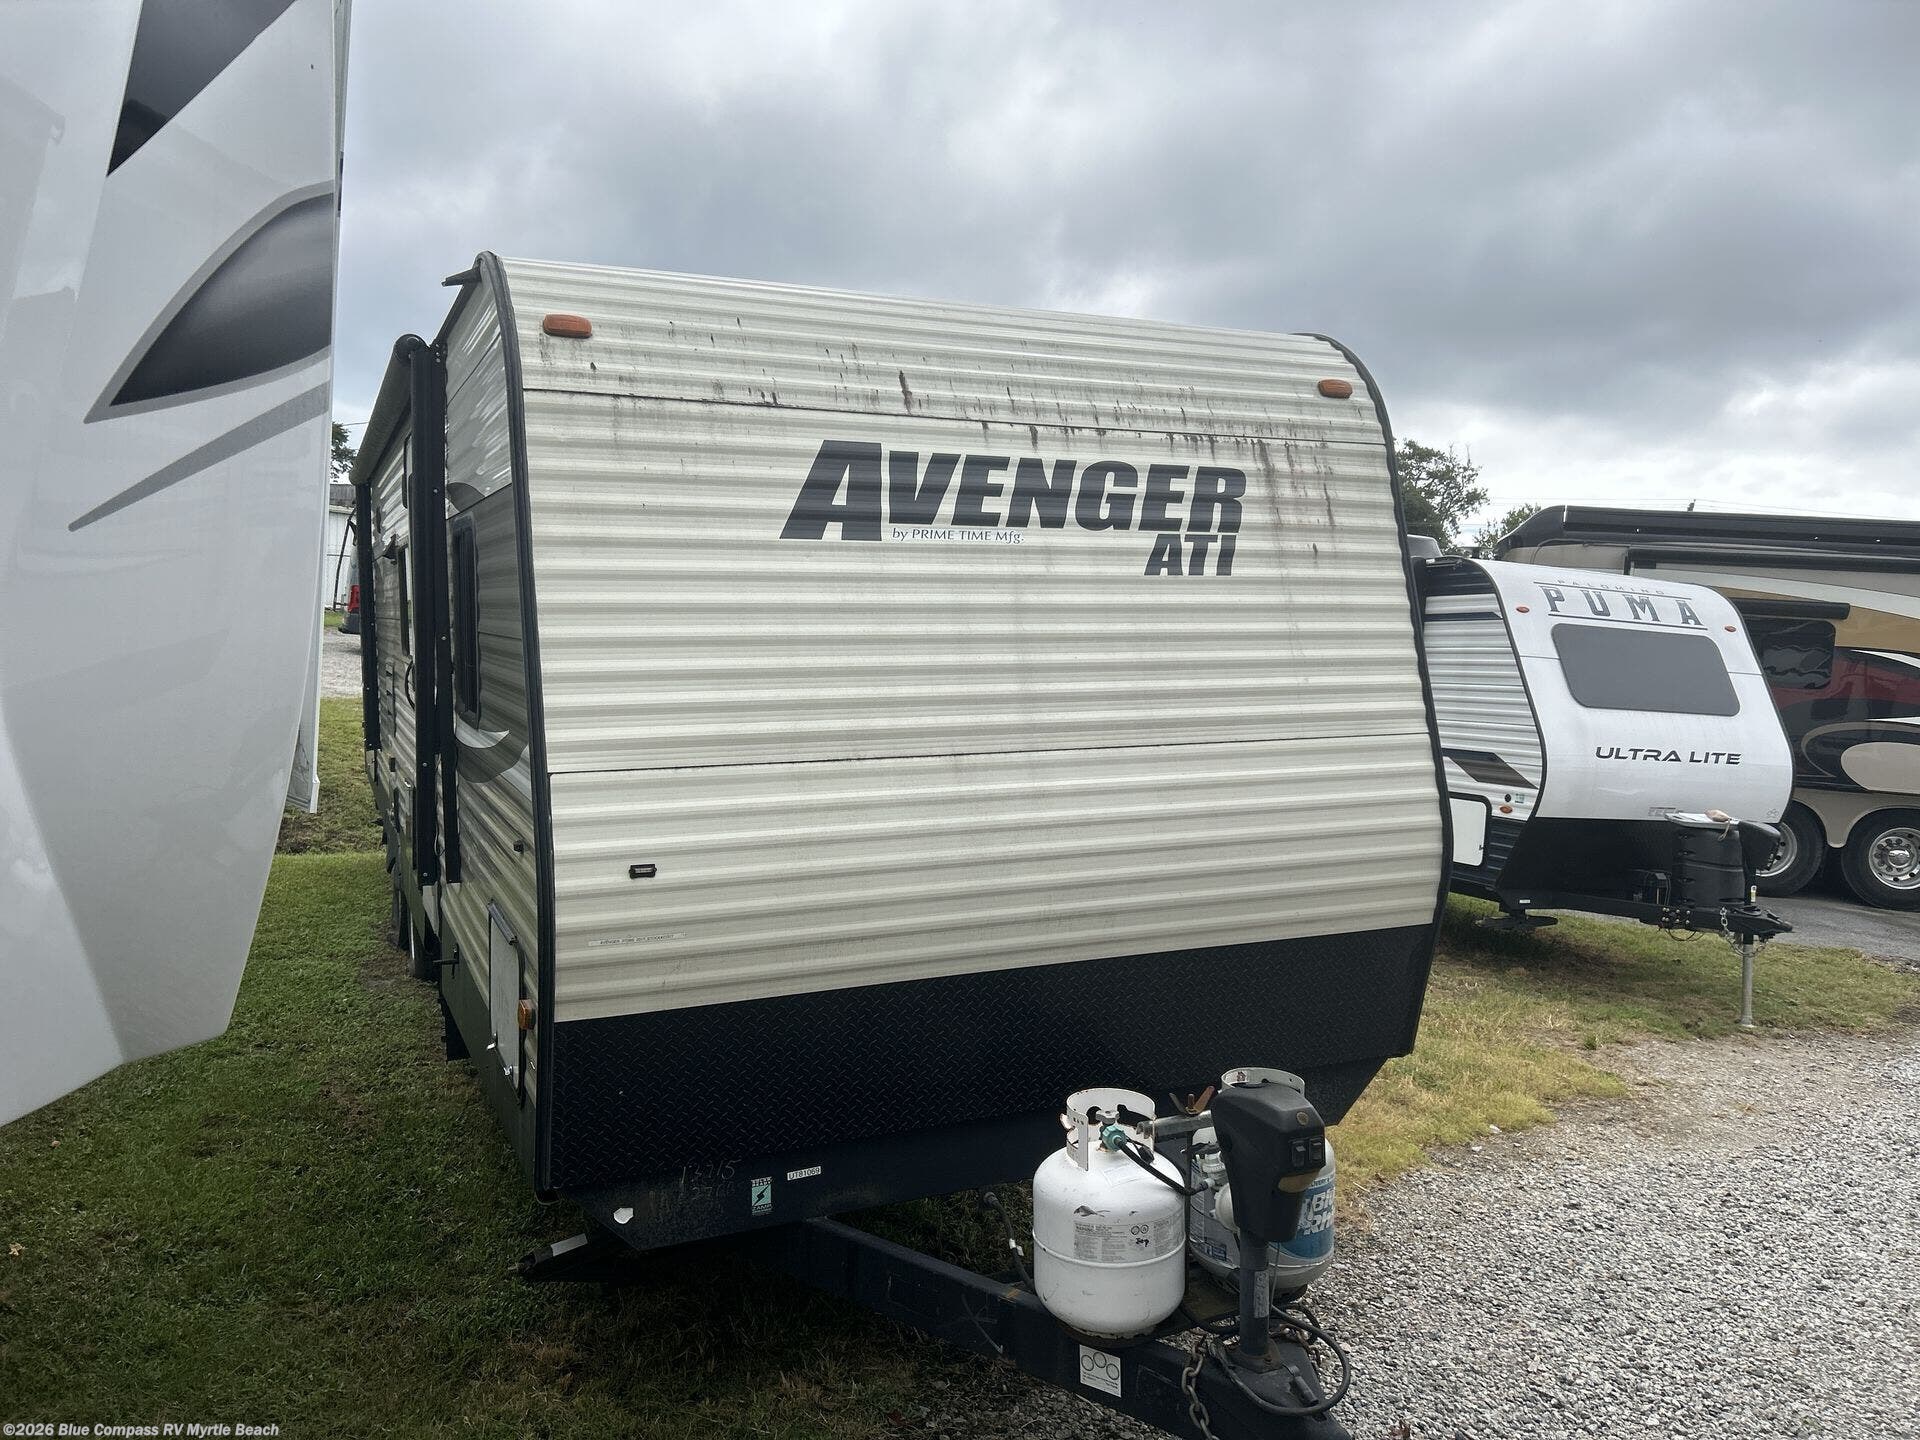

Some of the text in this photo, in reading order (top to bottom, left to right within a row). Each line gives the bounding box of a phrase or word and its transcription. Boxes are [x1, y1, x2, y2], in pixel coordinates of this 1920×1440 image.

[779, 439, 1247, 542] AVENGER
[892, 528, 1025, 544] by PRIME TIME Mfg.
[1144, 533, 1238, 576] ATI
[1557, 579, 1665, 595] PALOMINO
[1540, 585, 1704, 627] PUMA
[1595, 746, 1742, 765] ULTRA LITE
